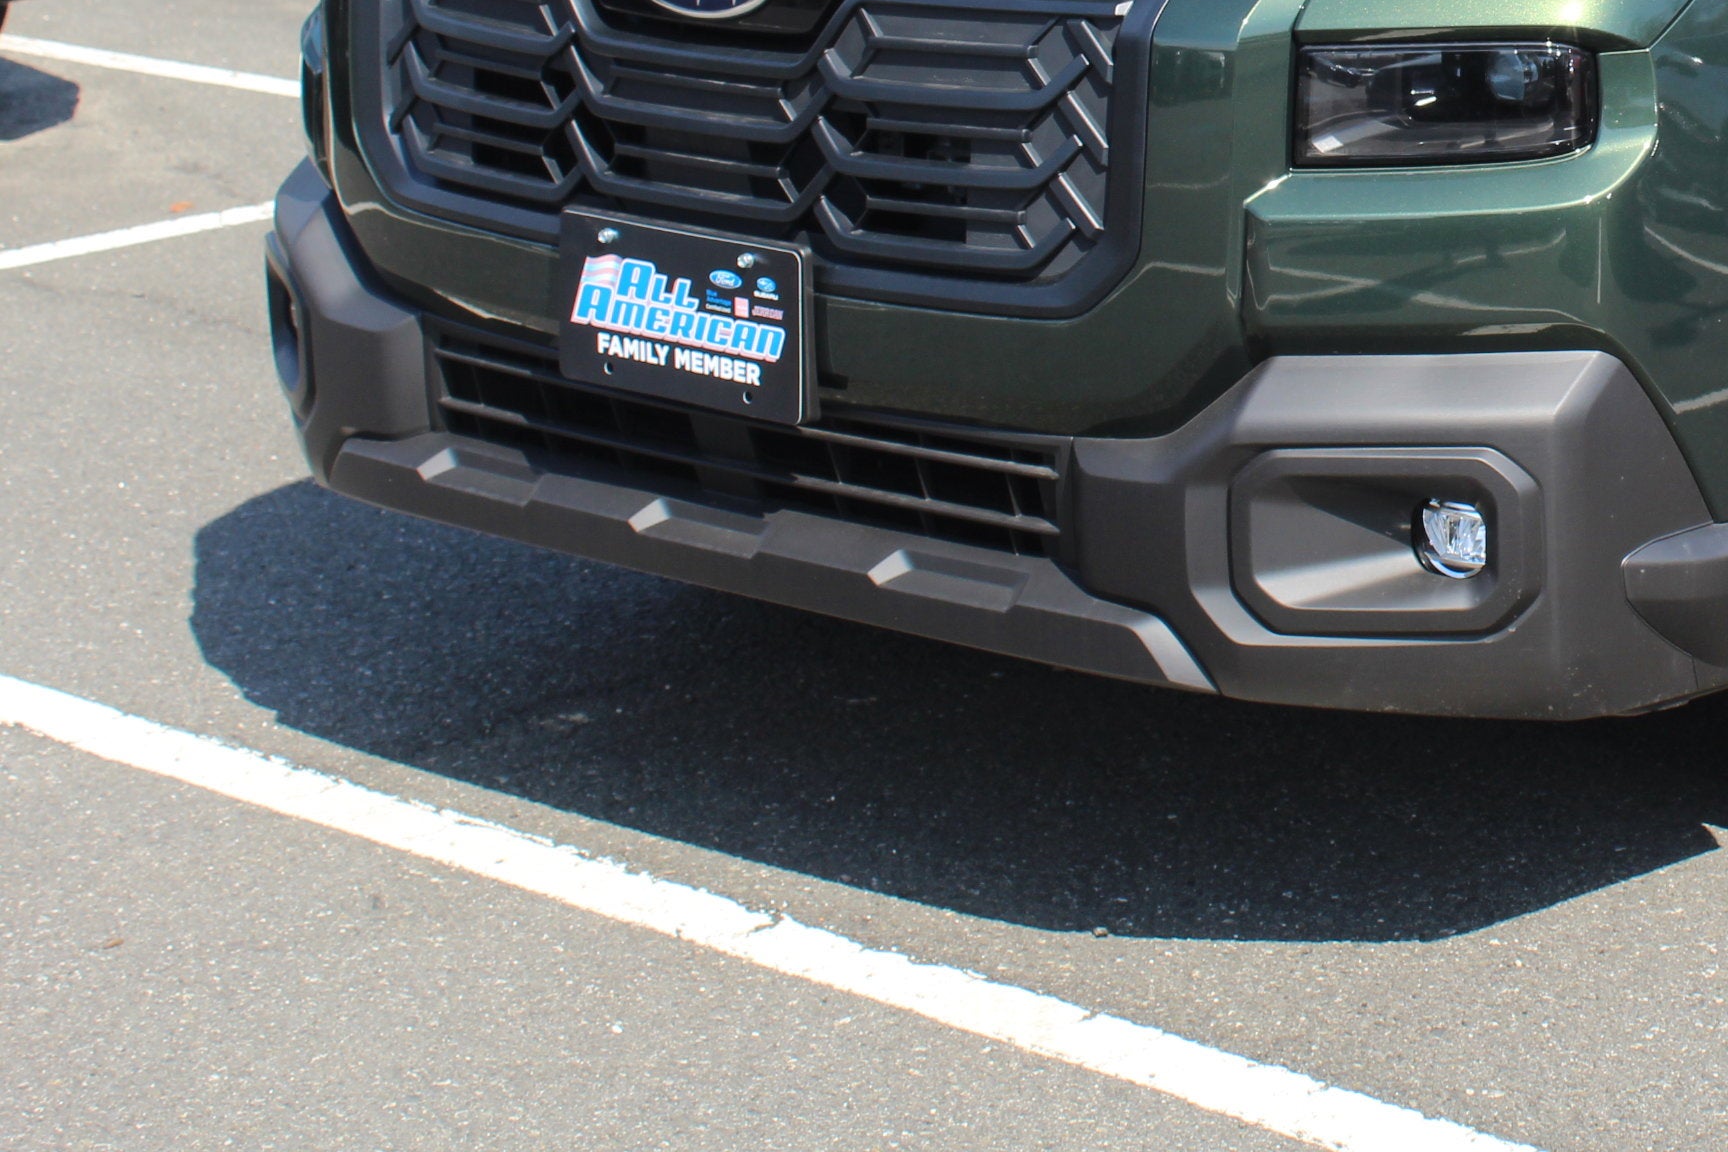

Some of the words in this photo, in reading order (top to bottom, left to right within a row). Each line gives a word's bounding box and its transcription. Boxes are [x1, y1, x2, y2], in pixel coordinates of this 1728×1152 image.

[617, 258, 700, 315] ALL
[571, 283, 786, 361] AMERICAN
[597, 333, 669, 366] FAMILY
[674, 348, 761, 386] MEMBER
